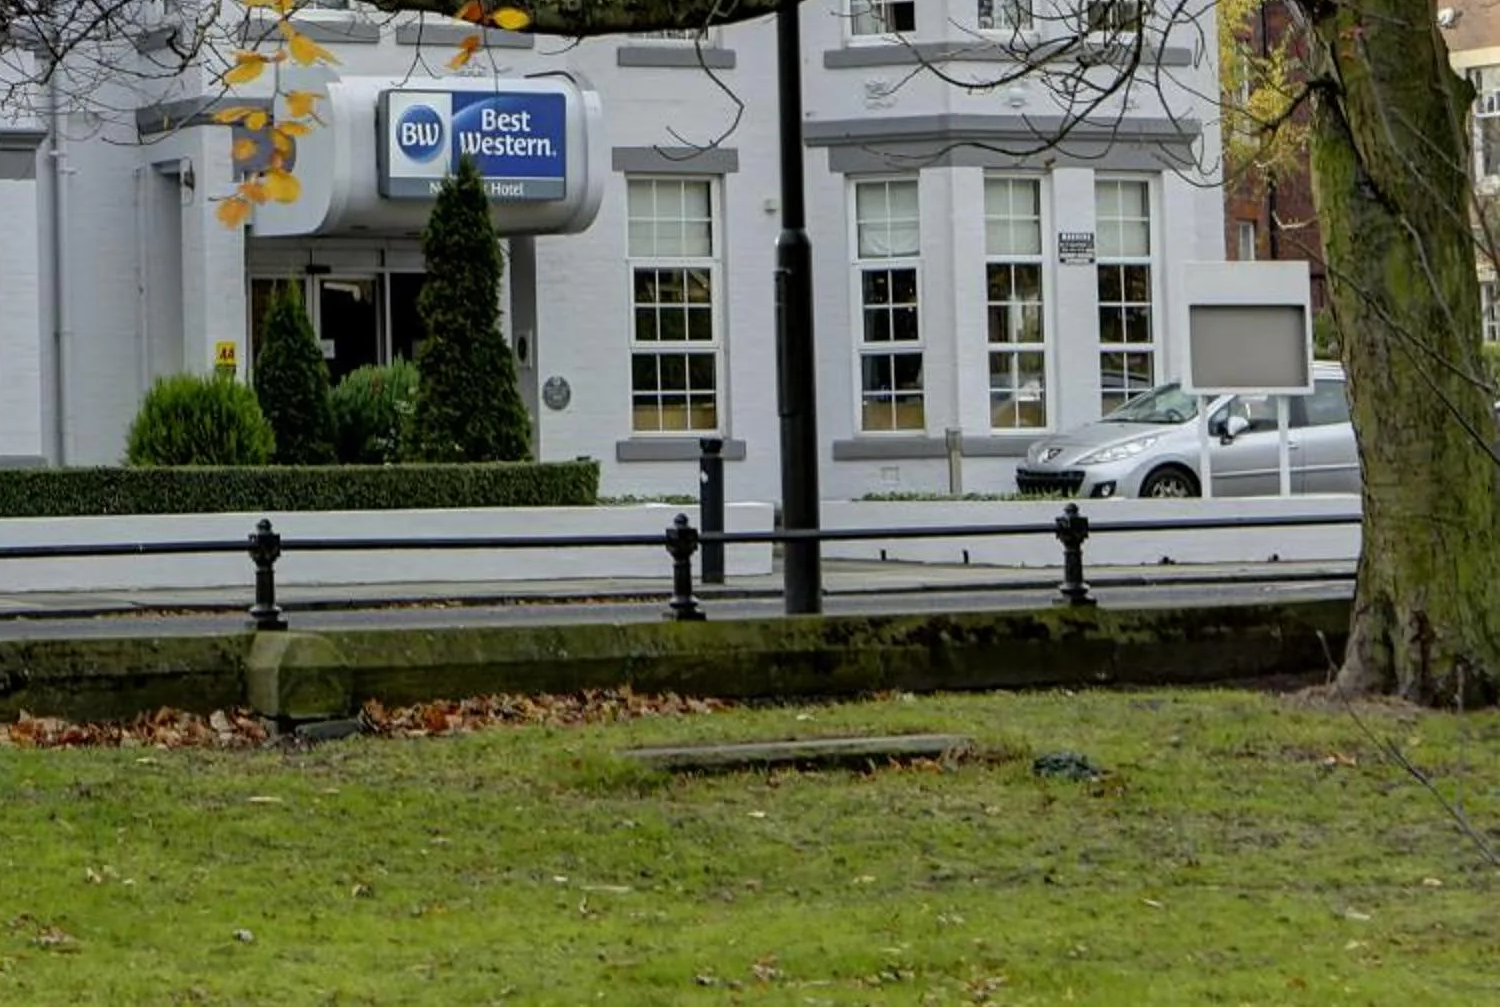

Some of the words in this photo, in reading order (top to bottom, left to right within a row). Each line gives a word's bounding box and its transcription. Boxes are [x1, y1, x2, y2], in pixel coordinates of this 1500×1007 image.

[481, 108, 531, 132] Best
[402, 122, 439, 146] BW
[459, 131, 551, 156] Western
[491, 181, 524, 196] Hotel
